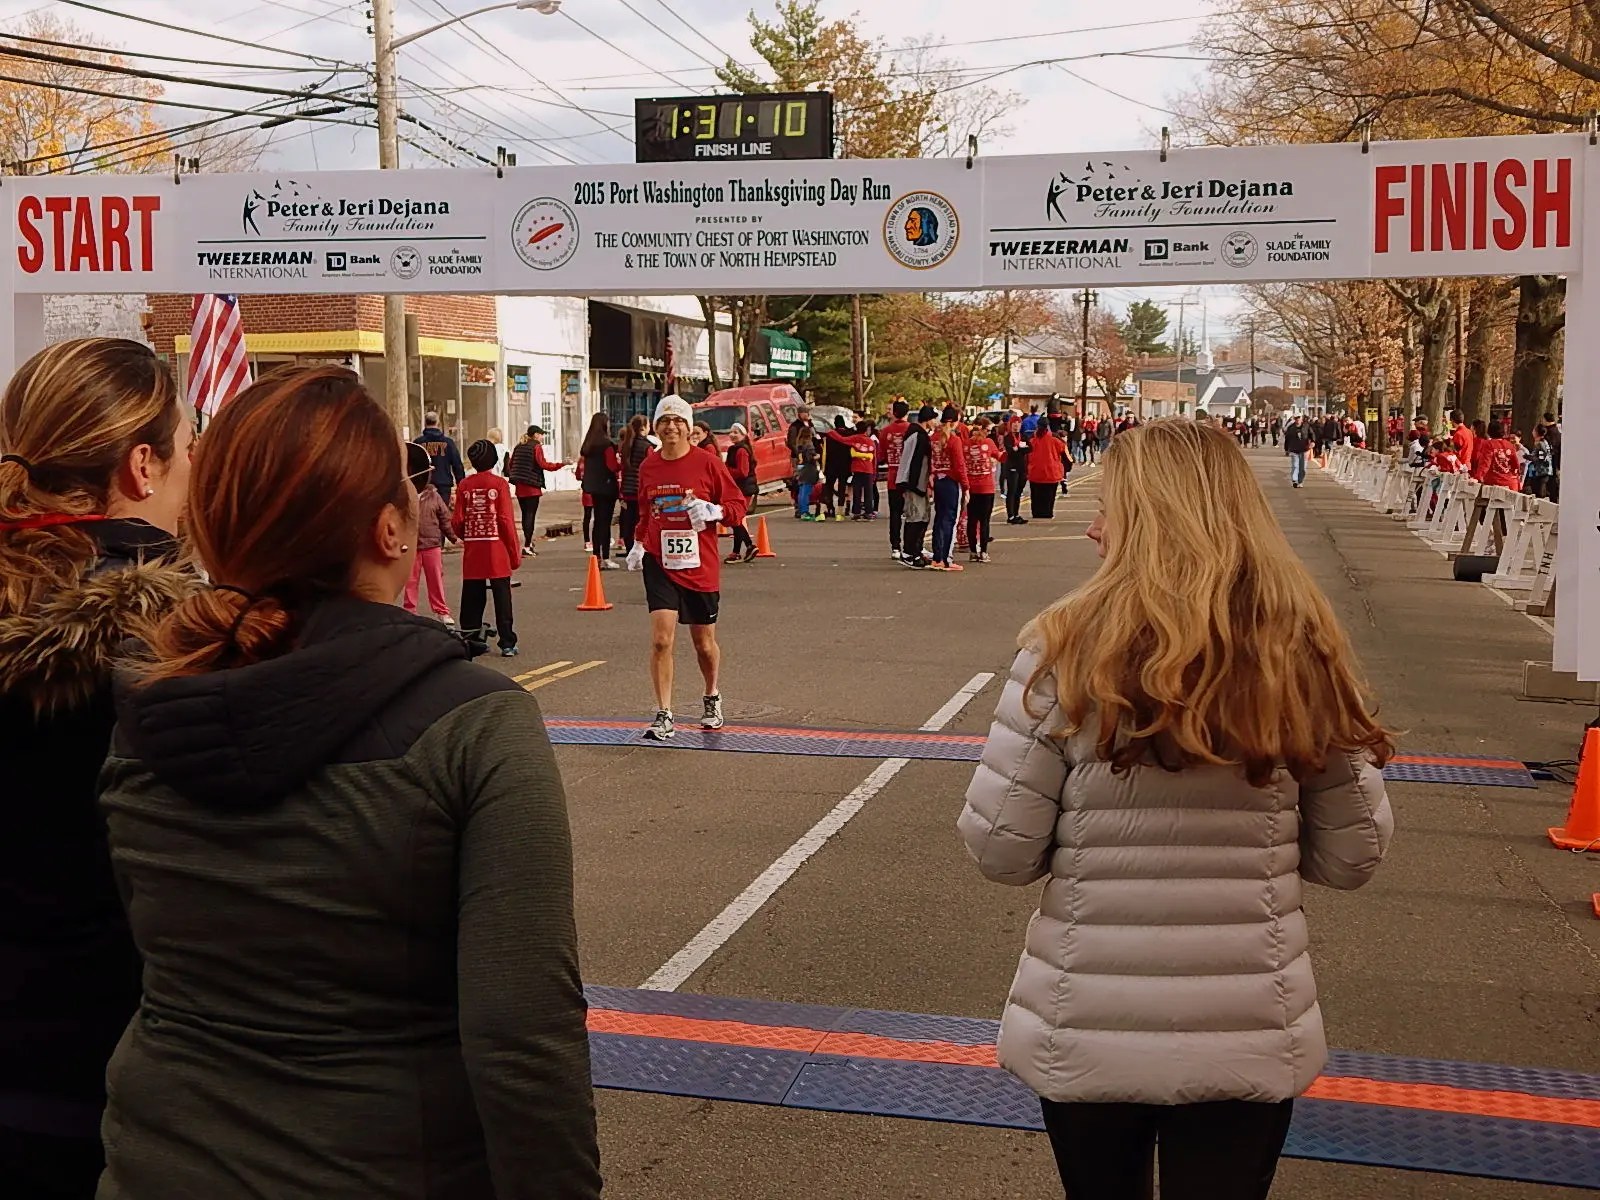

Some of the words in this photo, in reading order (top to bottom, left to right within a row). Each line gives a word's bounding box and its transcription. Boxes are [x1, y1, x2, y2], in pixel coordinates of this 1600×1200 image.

[695, 143, 738, 156] FINISH
[742, 142, 771, 154] LINE
[574, 182, 604, 204] 2015
[610, 182, 638, 204] Port
[643, 180, 723, 208] Washington
[729, 178, 825, 206] Thanksgiving
[831, 178, 857, 206] Day
[863, 178, 891, 200] Run
[1076, 184, 1138, 202] Peter
[1141, 185, 1156, 200] &
[1161, 181, 1204, 199] Jeri
[1208, 180, 1293, 200] Dejana
[268, 200, 319, 217] Peter
[321, 202, 334, 216] &
[338, 199, 374, 215] Jeri
[378, 199, 450, 217] Dejana
[1094, 203, 1162, 222] Family
[1169, 200, 1276, 216] Foundation
[1375, 158, 1571, 253] FINISH
[18, 195, 160, 273] START
[283, 218, 340, 236] Family
[346, 216, 434, 231] Foundation
[595, 232, 618, 247] THE
[622, 232, 692, 247] COMMUNITY
[696, 231, 734, 246] CHEST
[738, 232, 752, 246] OF
[757, 230, 788, 246] PORT
[793, 230, 869, 245] WASHINGTON
[1266, 241, 1296, 250] SLADE
[1300, 240, 1331, 249] FAMILY
[990, 239, 1128, 256] TWEEZERMAN
[1146, 241, 1167, 258] TD
[1173, 241, 1209, 251] Bank
[198, 251, 312, 265] TWEEZERMAN
[328, 254, 345, 269] TD
[351, 254, 380, 263] Bank
[428, 256, 453, 264] SLADE
[456, 255, 482, 263] FAMILY
[625, 254, 633, 268] &
[637, 254, 659, 268] THE
[663, 252, 696, 267] TOWN
[701, 253, 715, 267] OF
[720, 251, 759, 267] NORTH
[764, 251, 836, 267] HEMPSTEAD
[1003, 256, 1121, 270] INTERNATIONAL
[1268, 252, 1329, 261] FOUNDATION
[209, 267, 308, 278] INTERNATIONAL
[430, 266, 481, 274] FOUNDATION
[668, 539, 692, 553] 552
[1538, 552, 1554, 574] TNH
